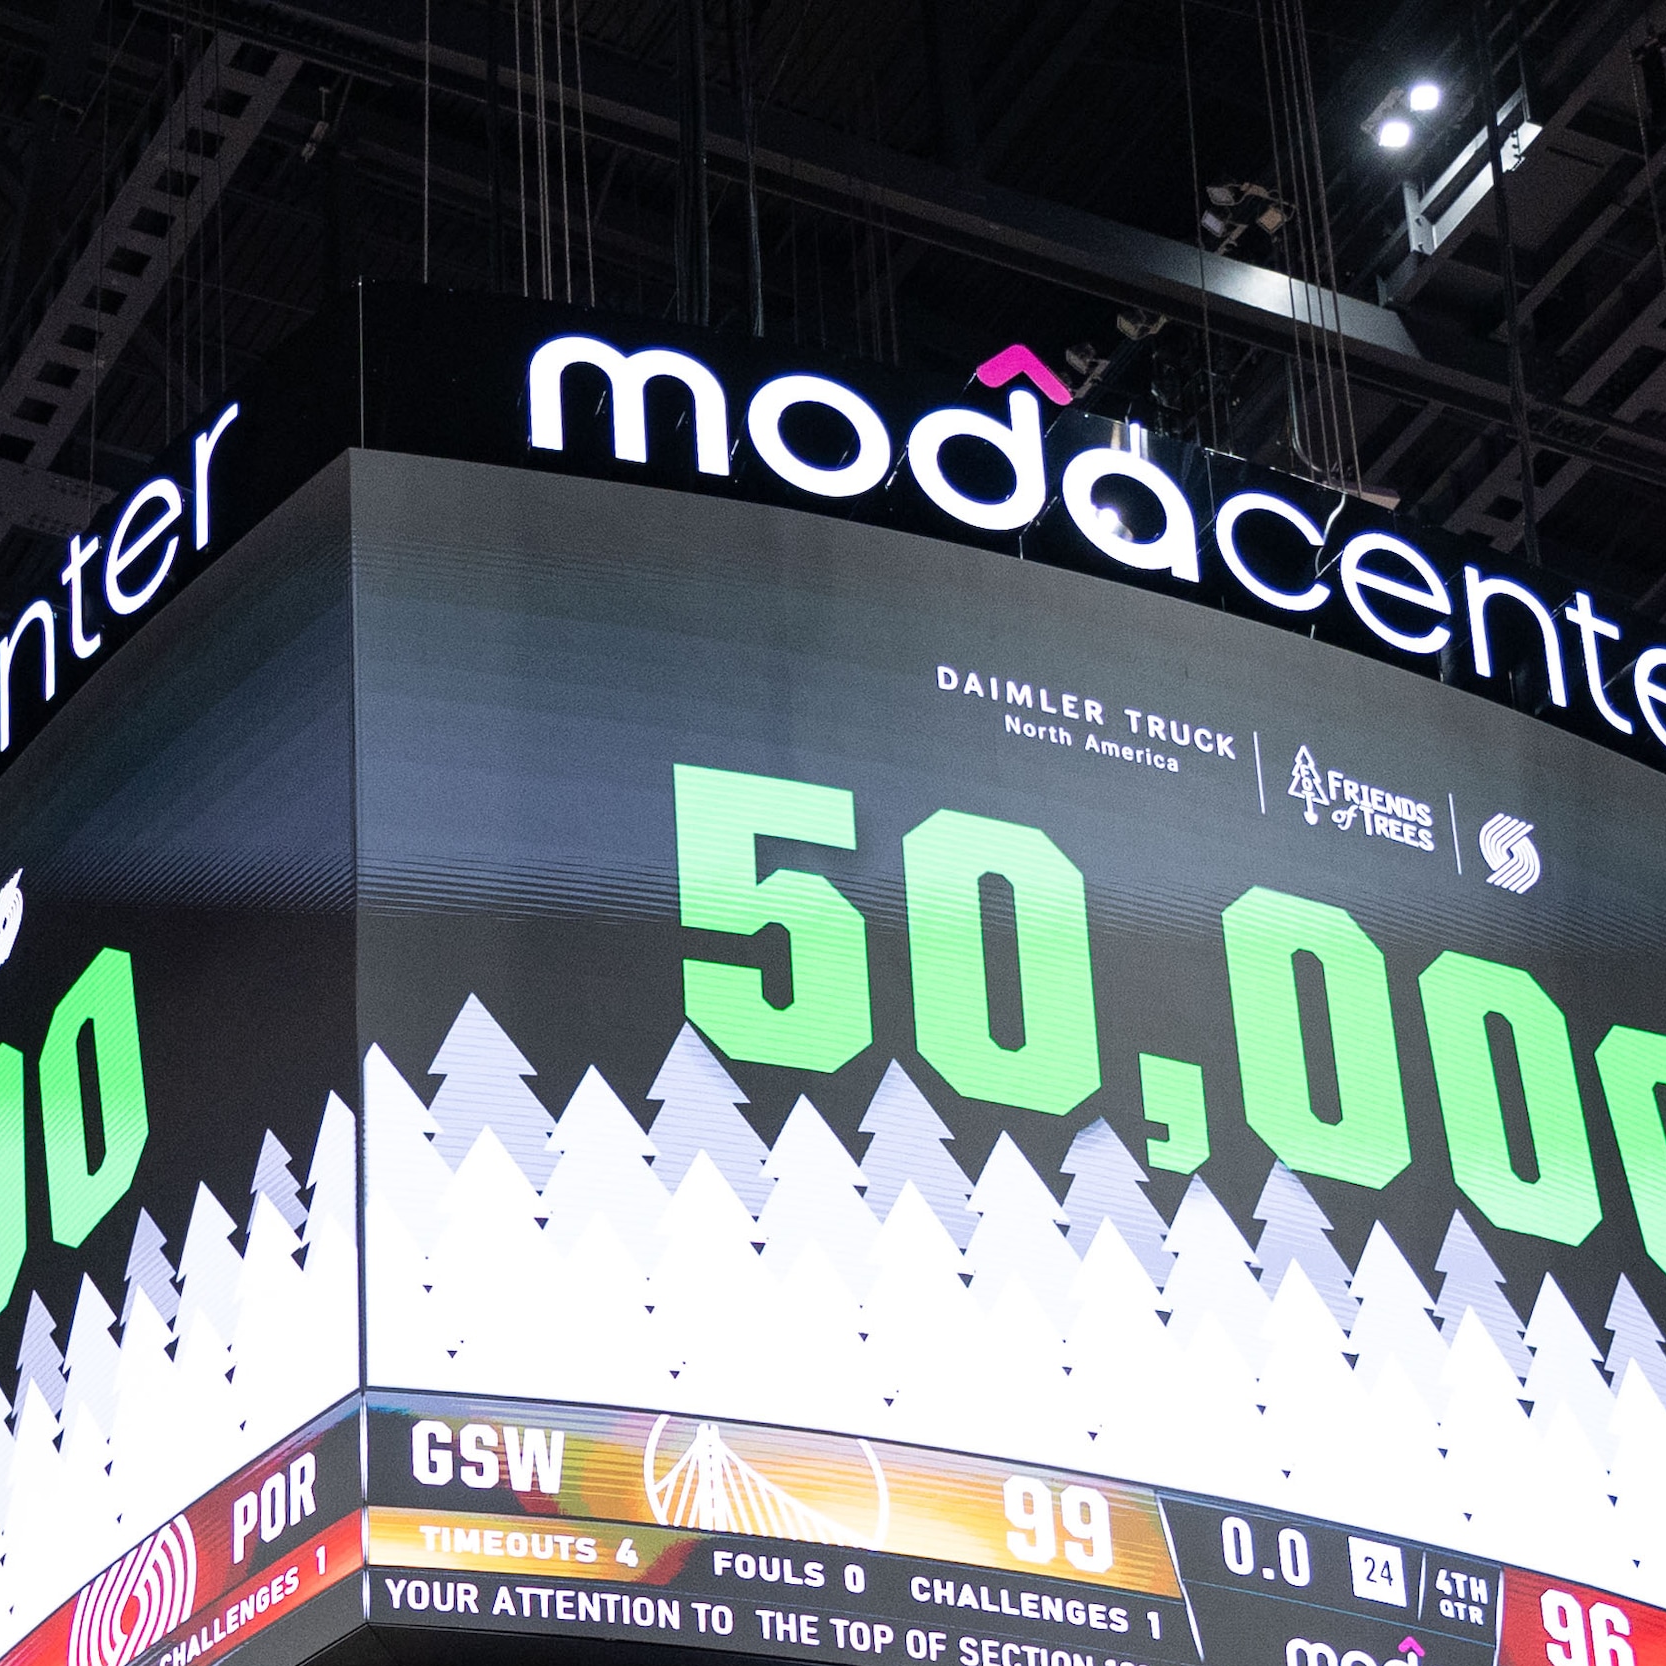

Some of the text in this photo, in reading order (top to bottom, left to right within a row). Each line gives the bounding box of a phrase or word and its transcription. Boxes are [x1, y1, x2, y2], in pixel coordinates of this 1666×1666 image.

[936, 665, 1237, 760] DAIMLER TRUCK
[1004, 713, 1180, 773] North America
[1327, 770, 1433, 827] FRIENDS
[1331, 805, 1434, 851] of TREES
[232, 1451, 316, 1564] POR
[410, 1419, 1114, 1574] GSW 99
[315, 1545, 326, 1576] 1
[1221, 1516, 1311, 1587] 0.0
[1362, 1557, 1395, 1589] 24
[419, 1526, 1161, 1640] TIMEOUTS 4 FOULS 0 CHALLENGES 1
[1435, 1568, 1489, 1605] 4TH
[1439, 1598, 1484, 1626] QTR
[384, 1578, 480, 1614] YOUR
[491, 1585, 681, 1630] ATTENTION
[690, 1602, 734, 1635] TO
[754, 1609, 820, 1646] THE
[828, 1618, 894, 1654] TOP
[905, 1629, 947, 1662] OF
